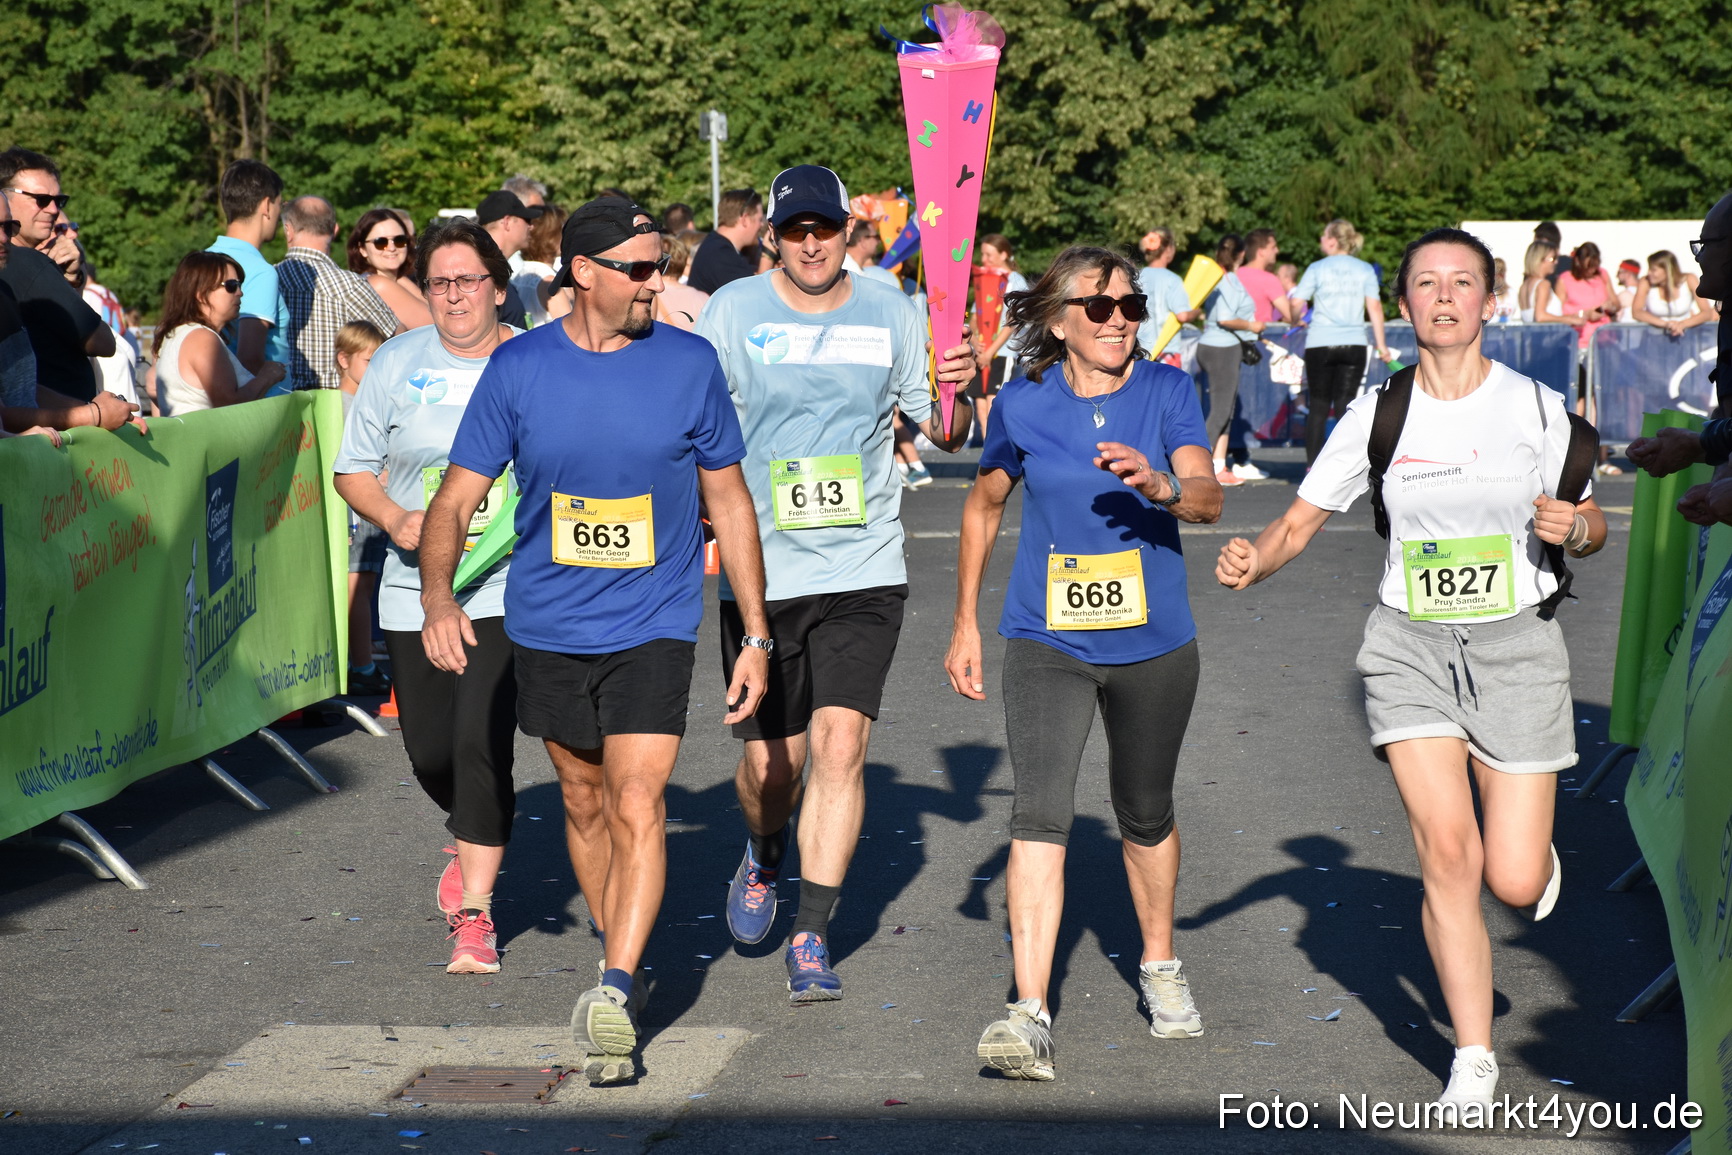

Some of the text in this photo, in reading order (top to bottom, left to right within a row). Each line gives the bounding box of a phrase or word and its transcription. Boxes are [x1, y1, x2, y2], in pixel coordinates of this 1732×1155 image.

[962, 100, 984, 124] H
[956, 164, 975, 188] Y
[921, 201, 943, 227] K
[1402, 467, 1462, 483] Seniorenstift
[1402, 475, 1523, 493] am Tiroler Hof Neumarkt
[791, 481, 843, 508] 643
[819, 506, 851, 514] Christian
[573, 522, 630, 549] 663
[576, 547, 630, 557] Geitner Georg
[1419, 564, 1498, 597] 1827
[199, 543, 257, 667] firmenlauf
[1067, 581, 1123, 609] 668
[1434, 596, 1486, 607] Pruy Sandra
[1061, 607, 1133, 617] Mitterhofer Monika
